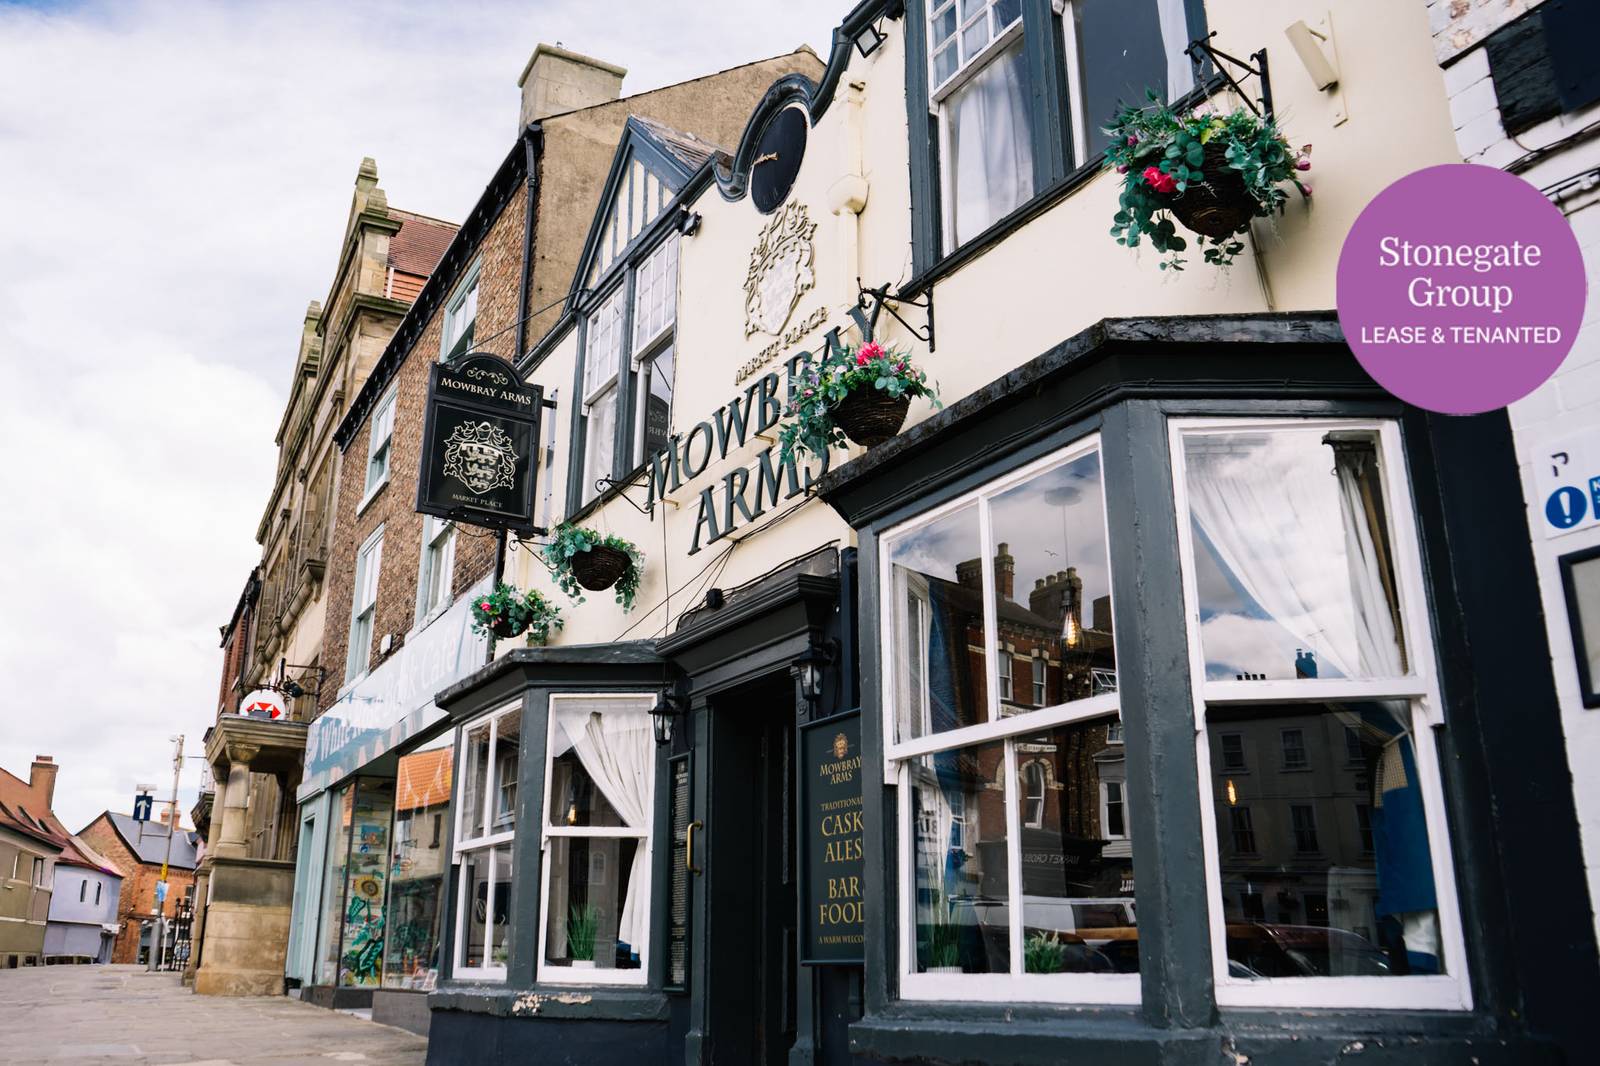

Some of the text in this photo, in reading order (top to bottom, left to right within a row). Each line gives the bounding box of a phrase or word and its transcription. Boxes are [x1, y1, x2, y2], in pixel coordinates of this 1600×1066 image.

[783, 306, 829, 350] PLACE
[441, 378, 532, 405] MOWBRAY ARMS
[452, 493, 503, 508] MARKET PLACE
[820, 756, 862, 777] MOWBRAY
[831, 770, 853, 785] ARMS
[821, 811, 864, 836] CASK
[824, 838, 862, 863] ALES
[828, 876, 861, 899] BAR
